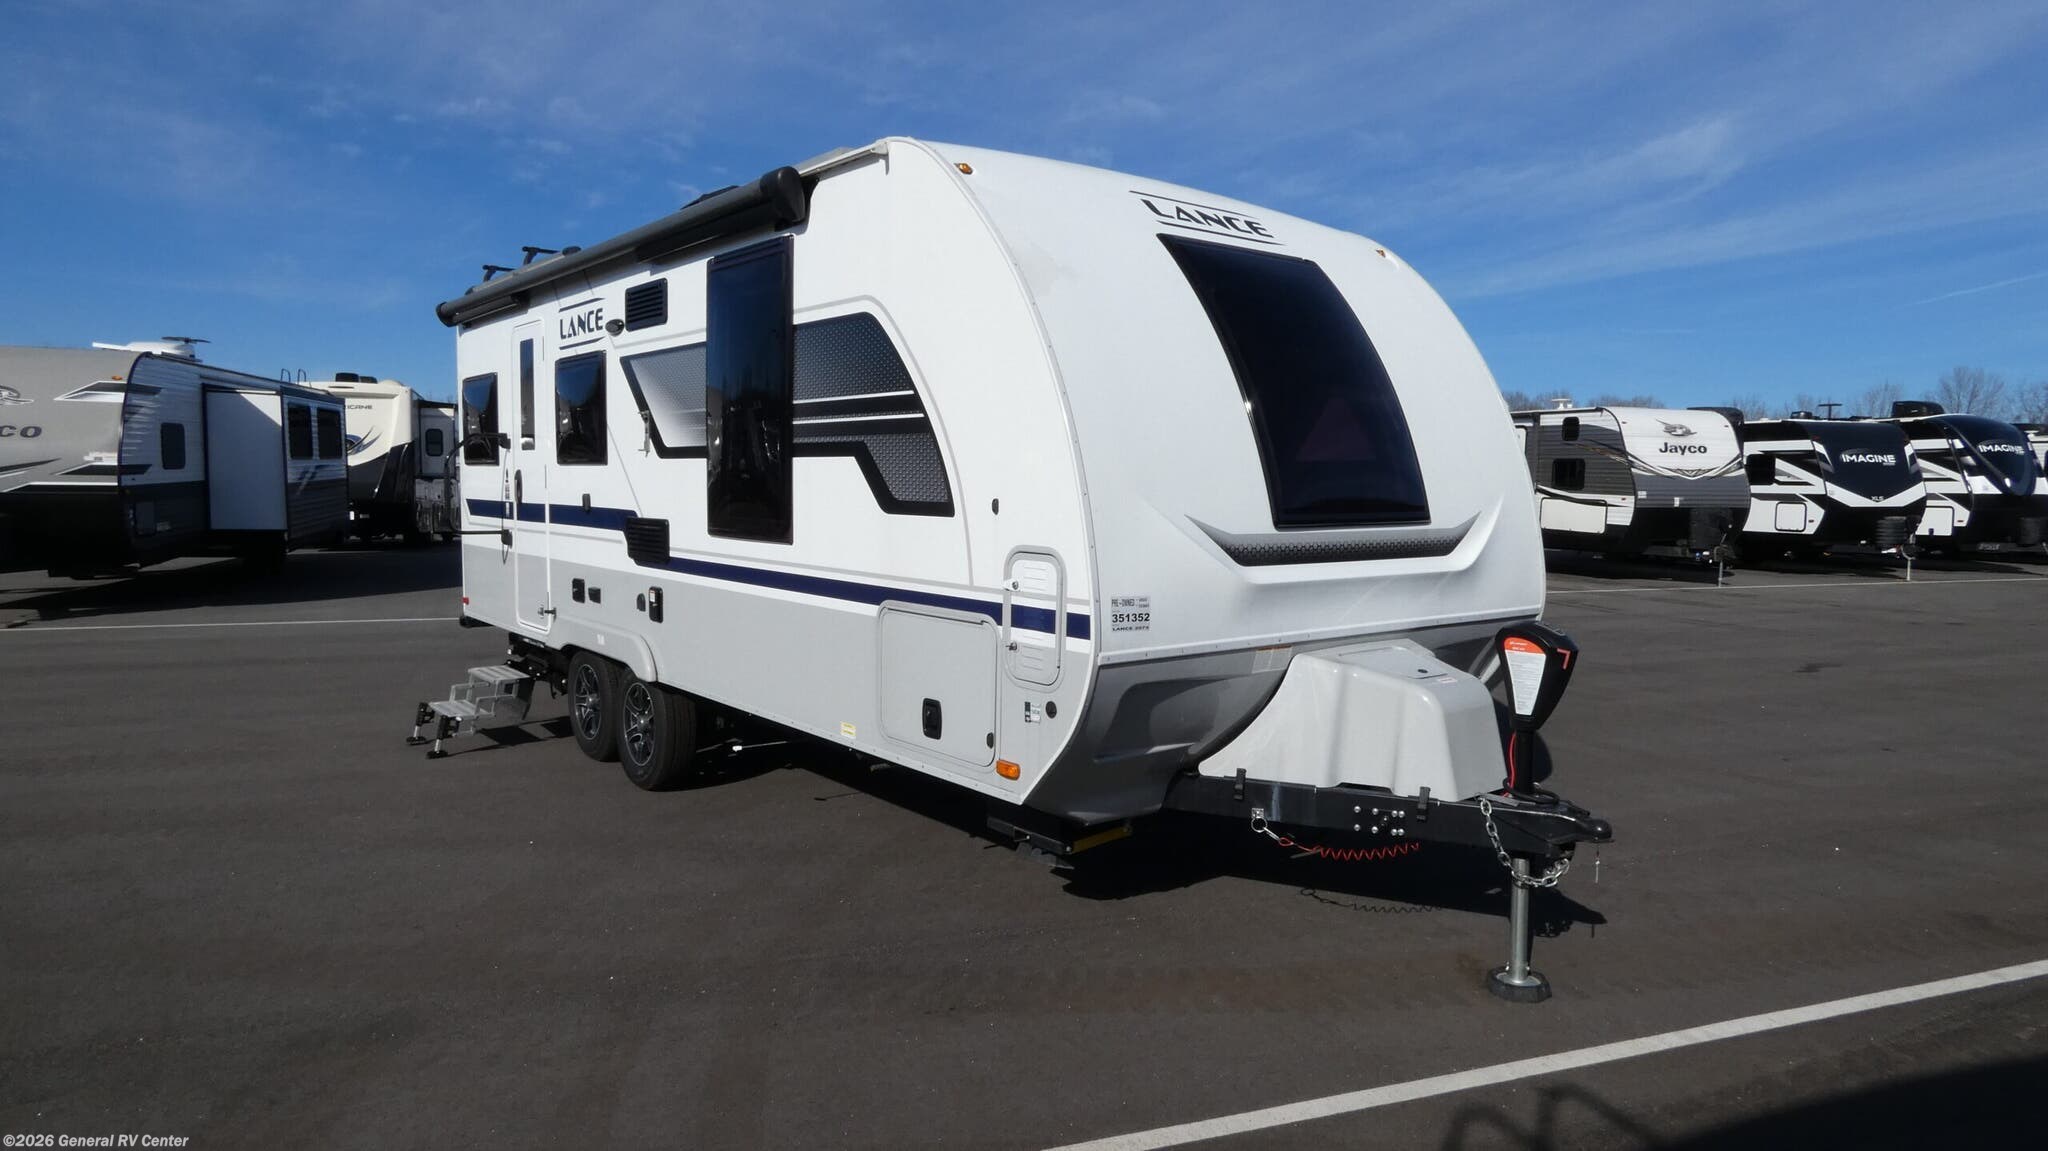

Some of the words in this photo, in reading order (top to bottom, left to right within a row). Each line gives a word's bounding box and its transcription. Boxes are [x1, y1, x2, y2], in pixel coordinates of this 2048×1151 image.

[1140, 199, 1275, 239] LANCE
[559, 308, 603, 340] LANCE
[1659, 442, 1707, 456] Jayco
[1977, 444, 2025, 453] IMAGINE
[1841, 453, 1896, 463] IMAGINE
[1111, 613, 1151, 623] 351352
